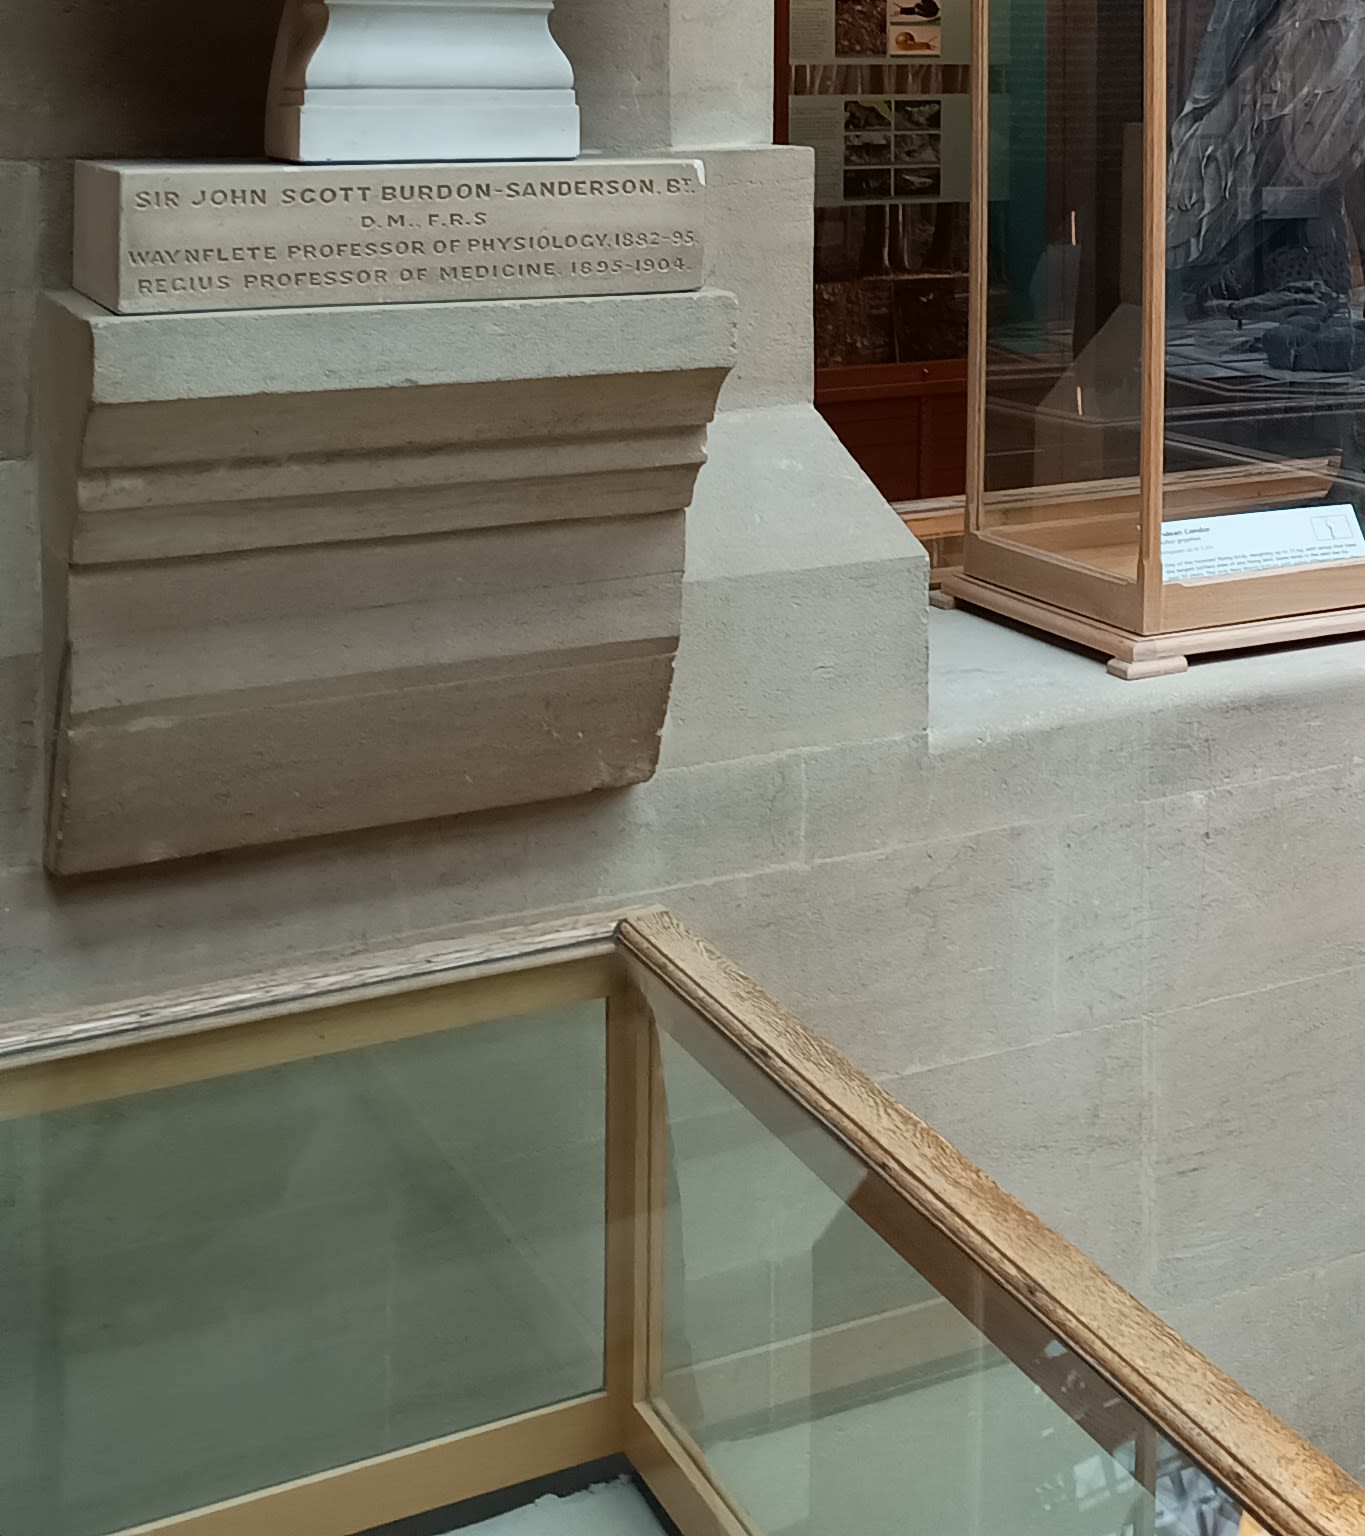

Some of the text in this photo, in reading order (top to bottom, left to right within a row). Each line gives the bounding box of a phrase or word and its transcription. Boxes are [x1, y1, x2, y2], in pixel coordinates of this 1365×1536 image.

[135, 191, 180, 209] SIR
[191, 188, 267, 207] JOHN
[281, 186, 372, 205] SCOTT
[128, 246, 277, 265] WAYNFLETE
[287, 240, 425, 260] PROFESSOR
[433, 239, 461, 255] OF
[138, 275, 231, 294] REGIUS
[244, 269, 388, 289] PROFESSOR
[400, 267, 427, 282] OF
